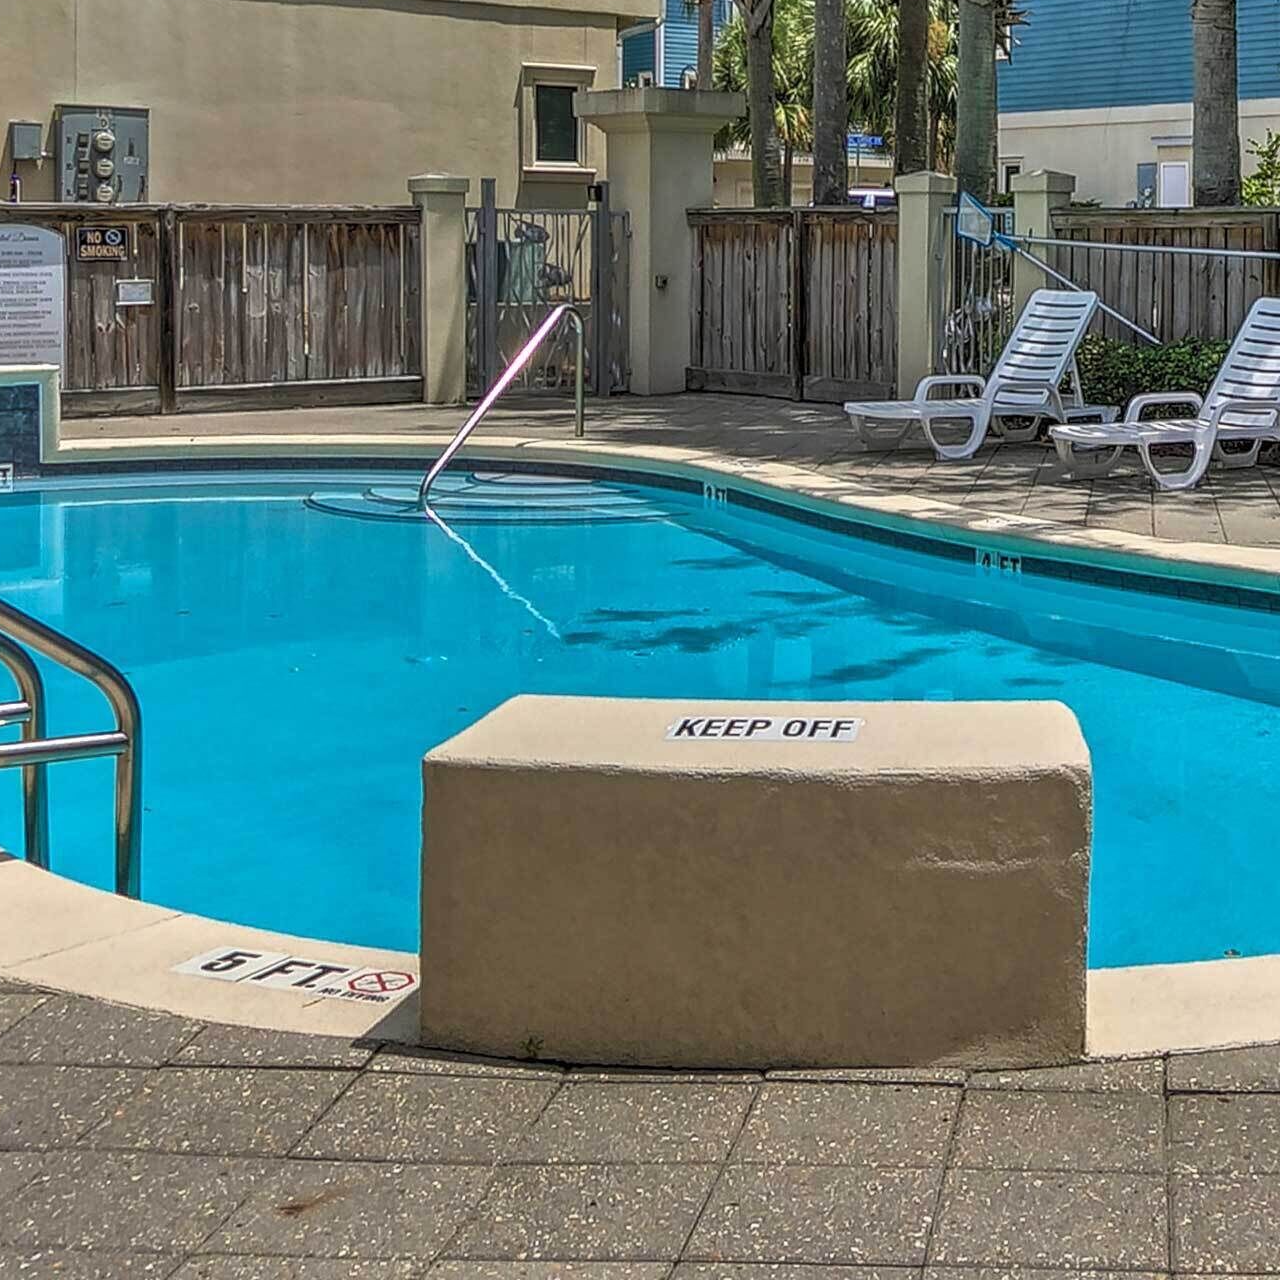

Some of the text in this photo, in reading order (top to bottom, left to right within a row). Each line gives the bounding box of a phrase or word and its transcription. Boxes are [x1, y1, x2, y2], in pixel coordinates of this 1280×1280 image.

[86, 231, 101, 243] NO
[81, 245, 125, 257] SMOKING
[673, 719, 855, 738] KEEP OFF
[200, 950, 263, 971] 5
